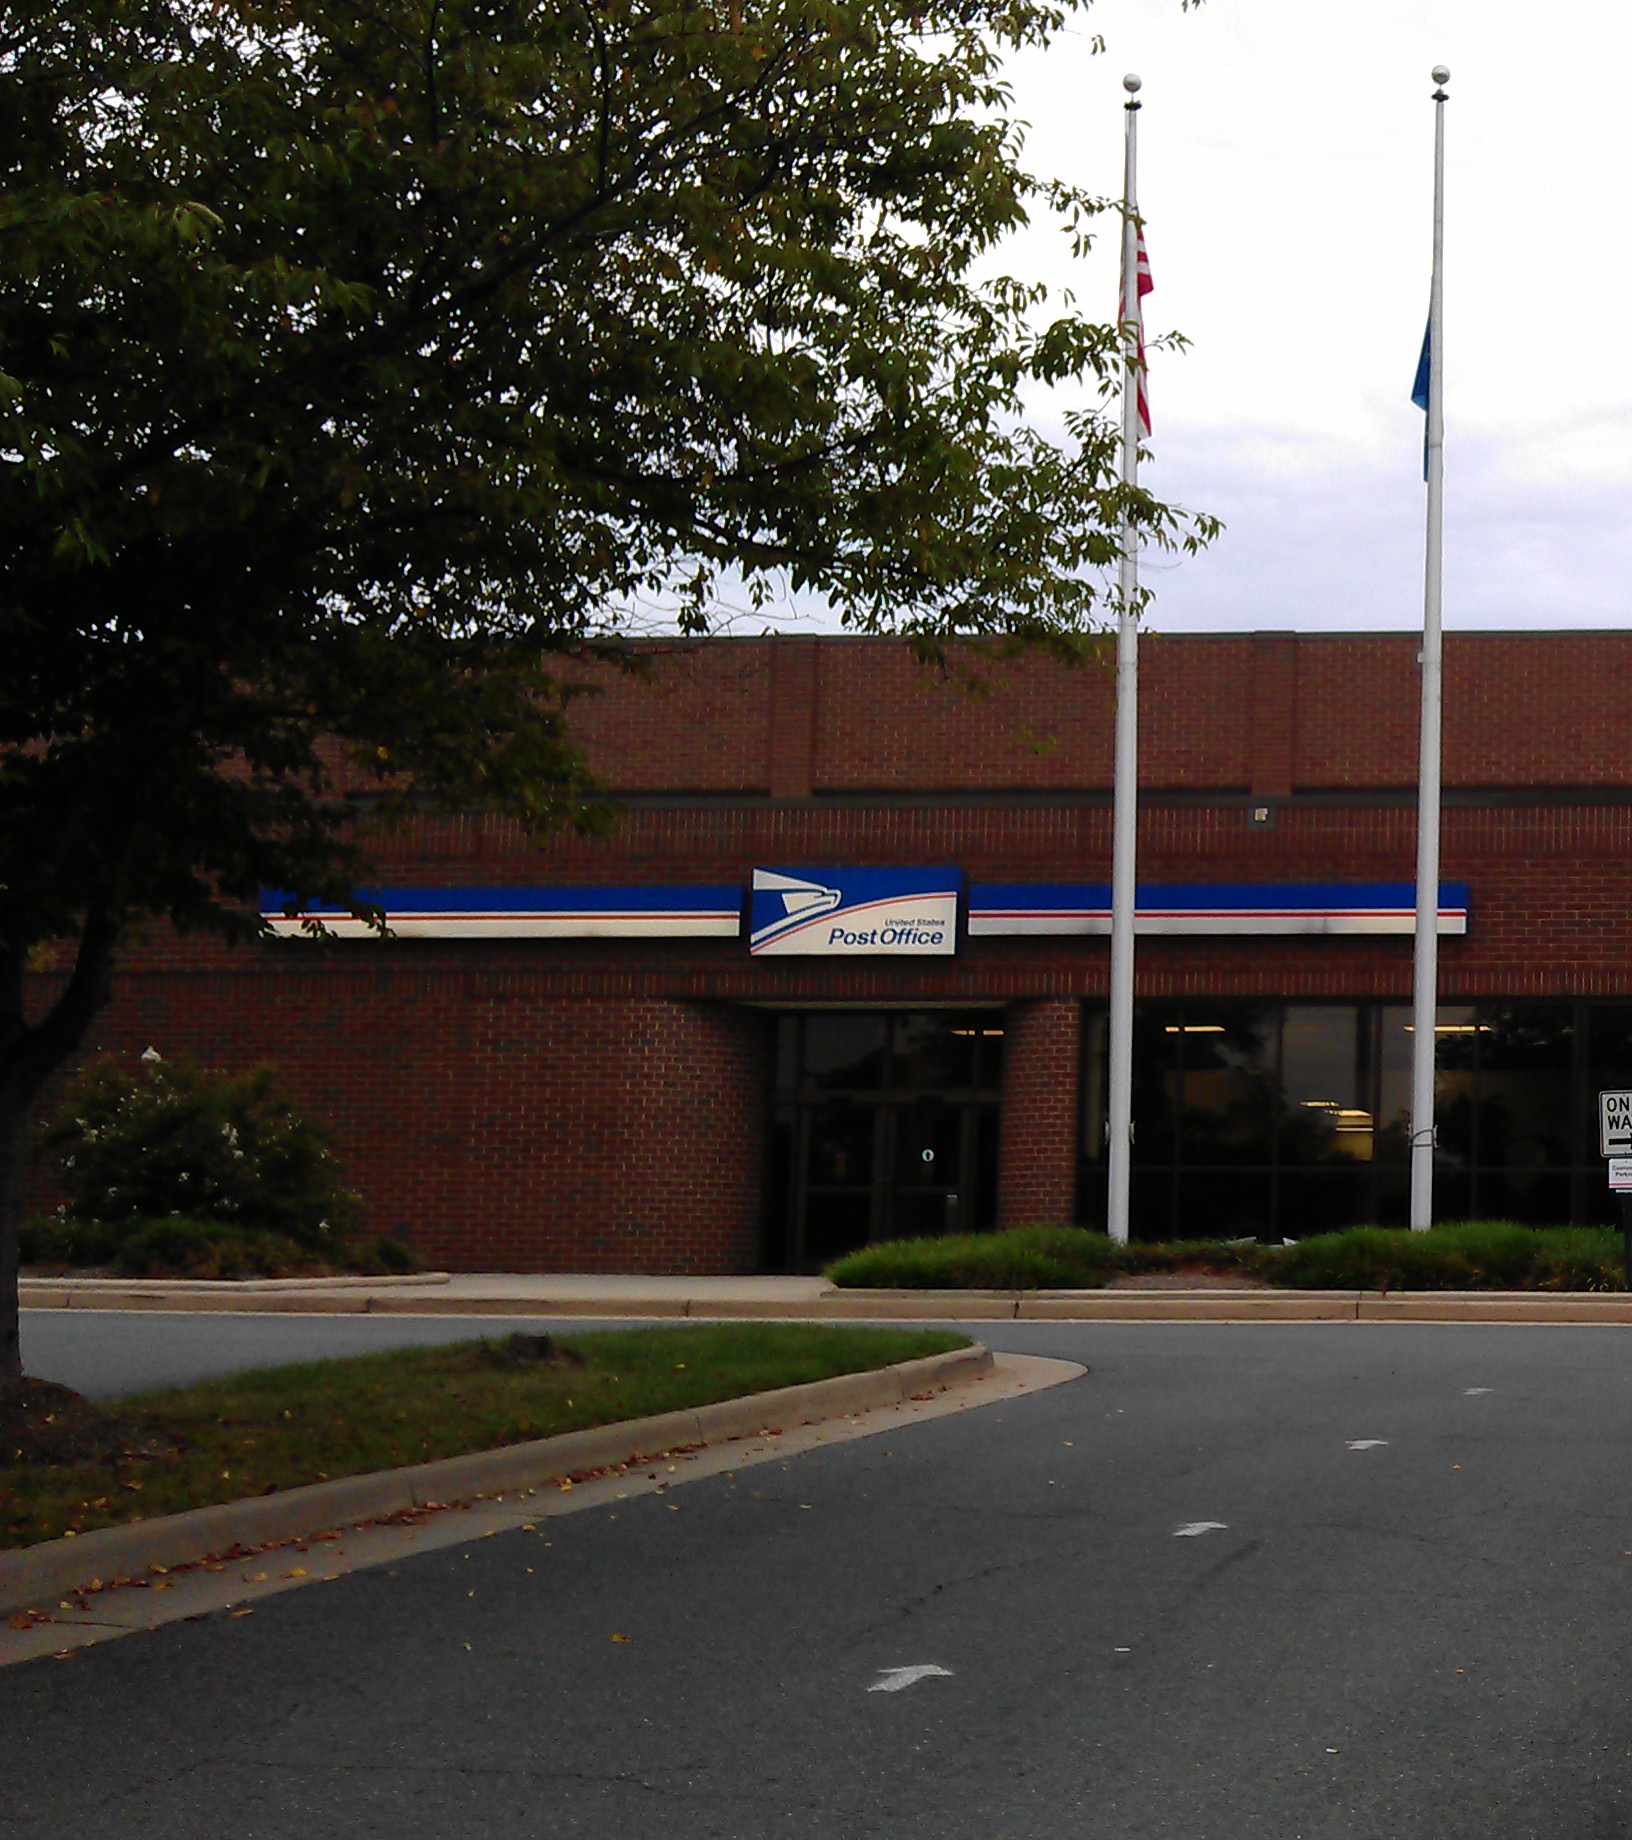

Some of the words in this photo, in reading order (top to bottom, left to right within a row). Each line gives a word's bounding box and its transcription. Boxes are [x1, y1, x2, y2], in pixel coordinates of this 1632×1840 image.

[885, 918, 915, 926] United
[917, 918, 945, 926] States
[829, 928, 877, 945] Post
[880, 927, 943, 945] Office
